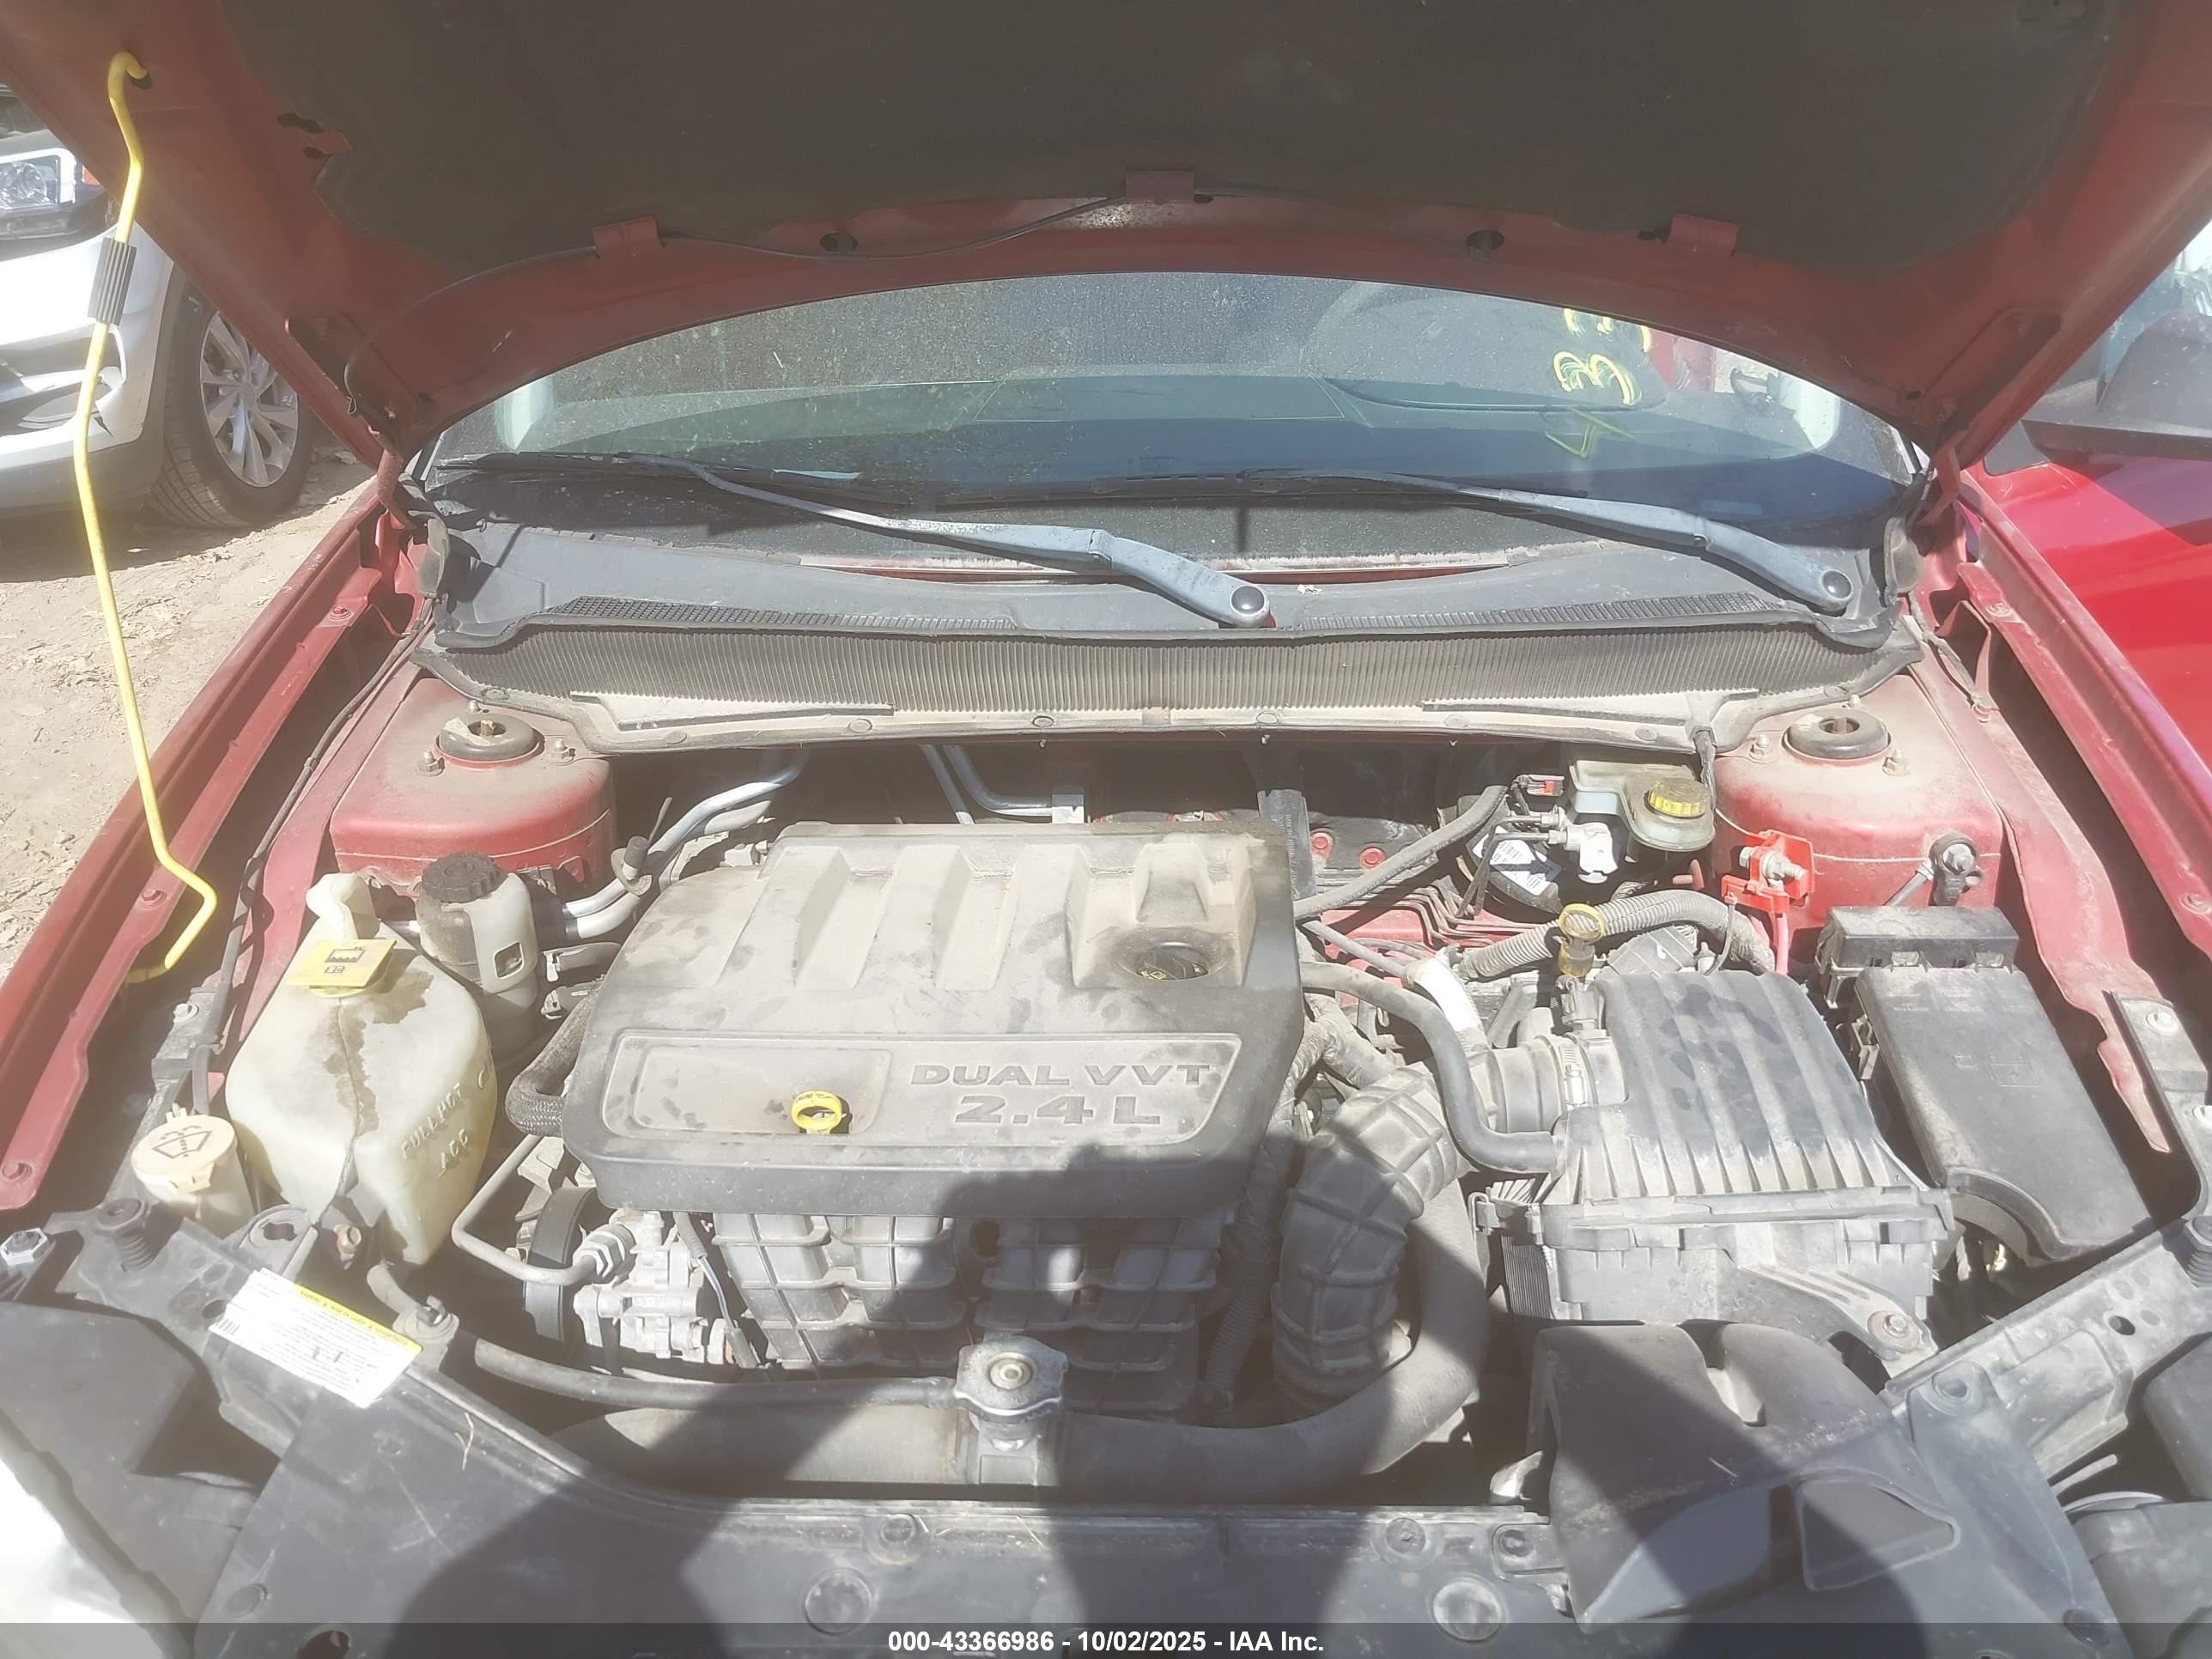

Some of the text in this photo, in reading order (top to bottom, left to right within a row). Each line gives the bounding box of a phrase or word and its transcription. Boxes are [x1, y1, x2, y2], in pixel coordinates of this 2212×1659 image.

[910, 1064, 1210, 1086] DUAL VVT
[955, 1096, 1161, 1124] 2.4 L
[401, 1115, 439, 1159] FULL
